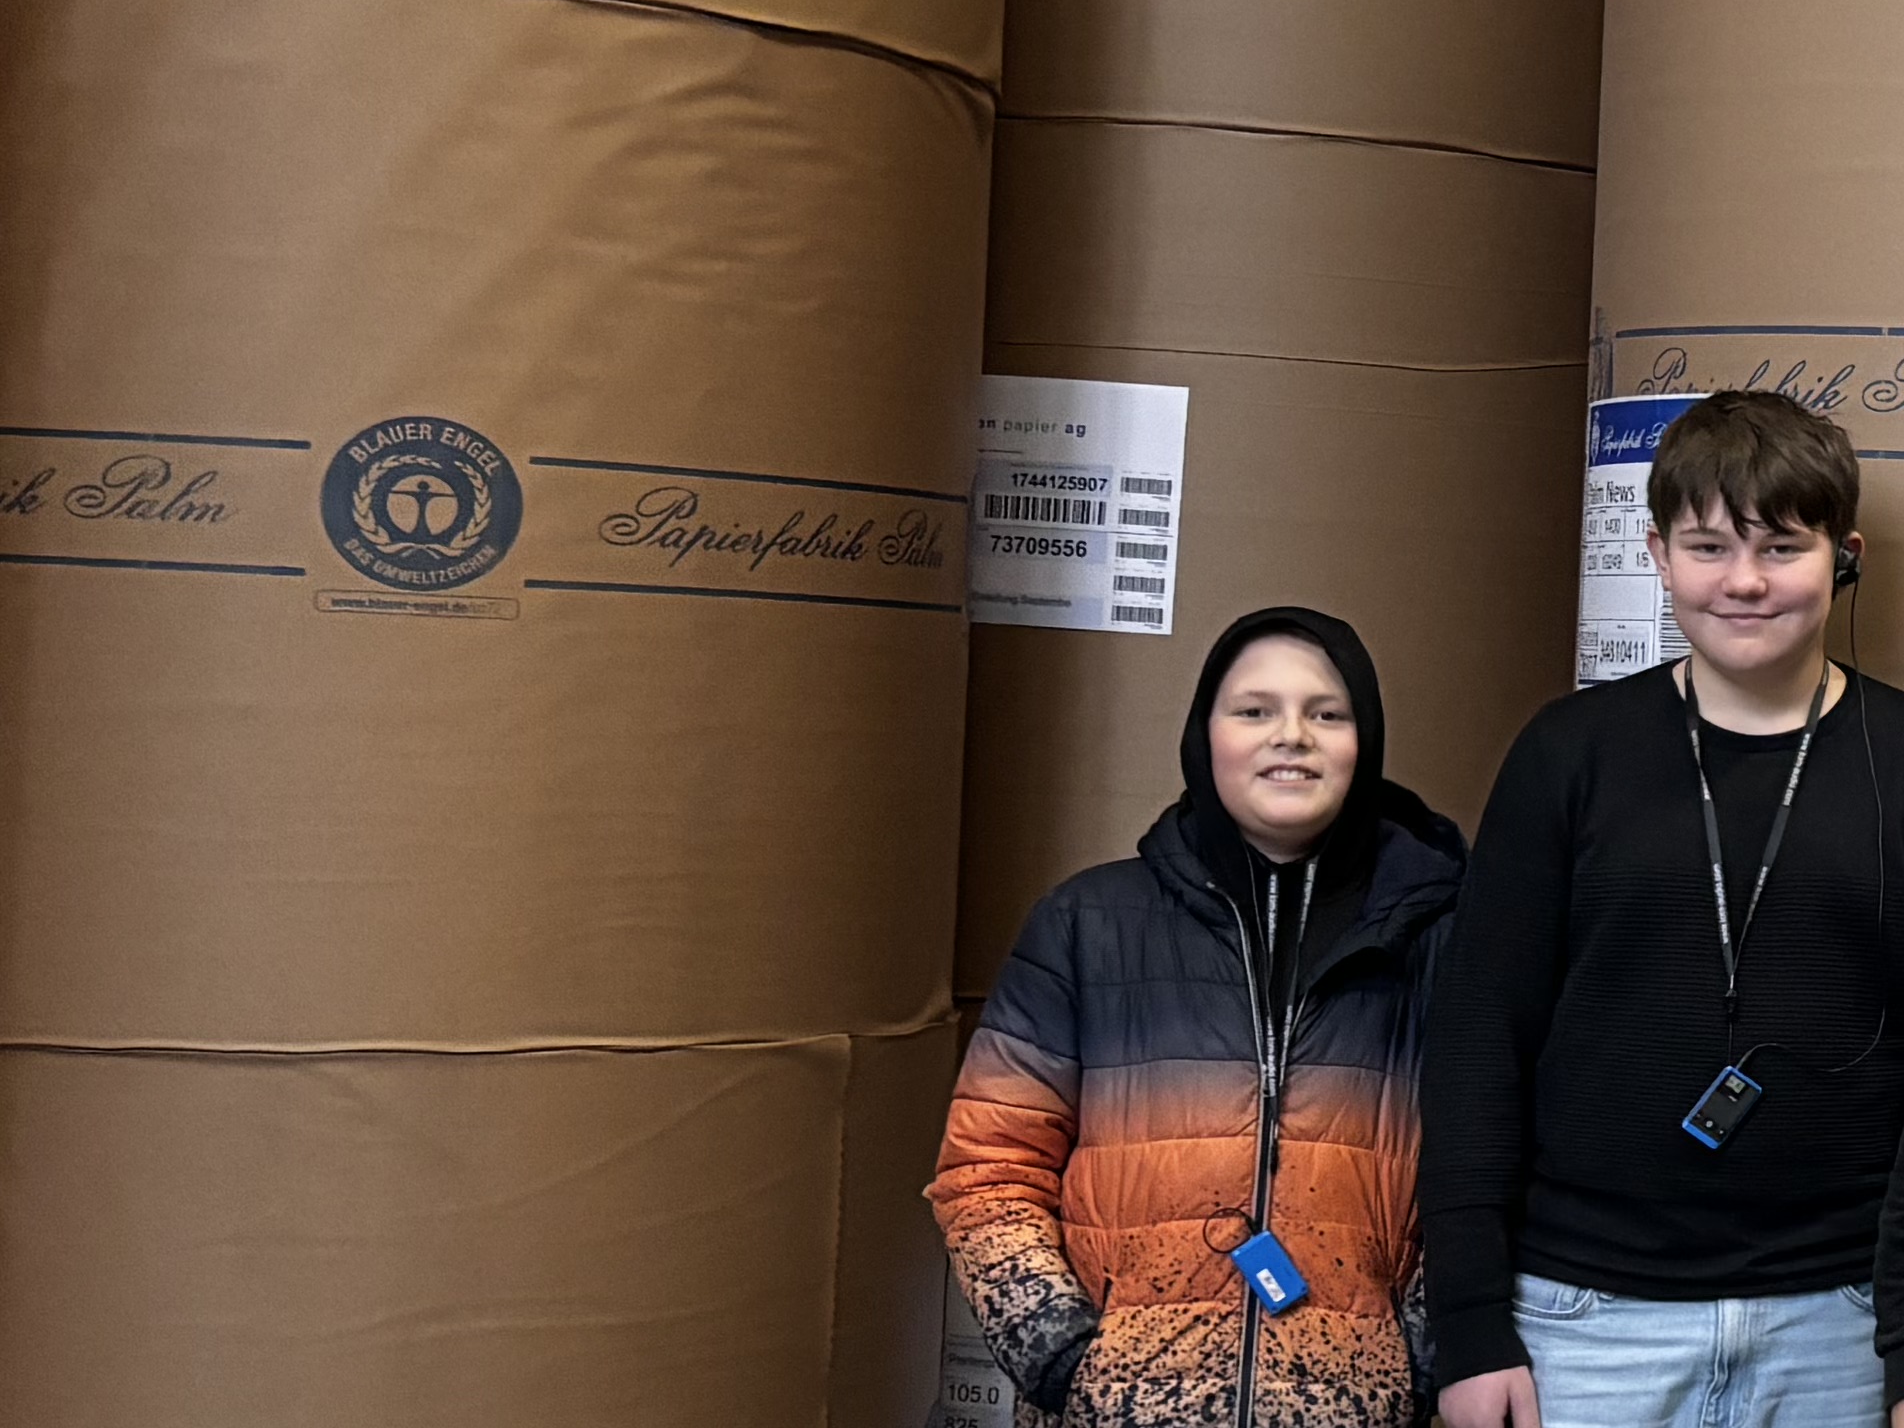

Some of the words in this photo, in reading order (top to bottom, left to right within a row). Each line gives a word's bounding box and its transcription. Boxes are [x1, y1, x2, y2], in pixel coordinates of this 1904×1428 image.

[1003, 420, 1057, 432] papier
[1065, 423, 1086, 437] ag
[349, 423, 433, 466] BLAUER
[440, 427, 499, 478] ENGEL
[63, 454, 232, 525] Palm
[1011, 473, 1108, 491] 1744125907
[599, 486, 867, 570] Papierfabrik
[878, 508, 944, 570] Palm
[343, 538, 371, 568] DAS
[990, 534, 1087, 558] 73709556
[949, 1385, 999, 1404] 105.0
